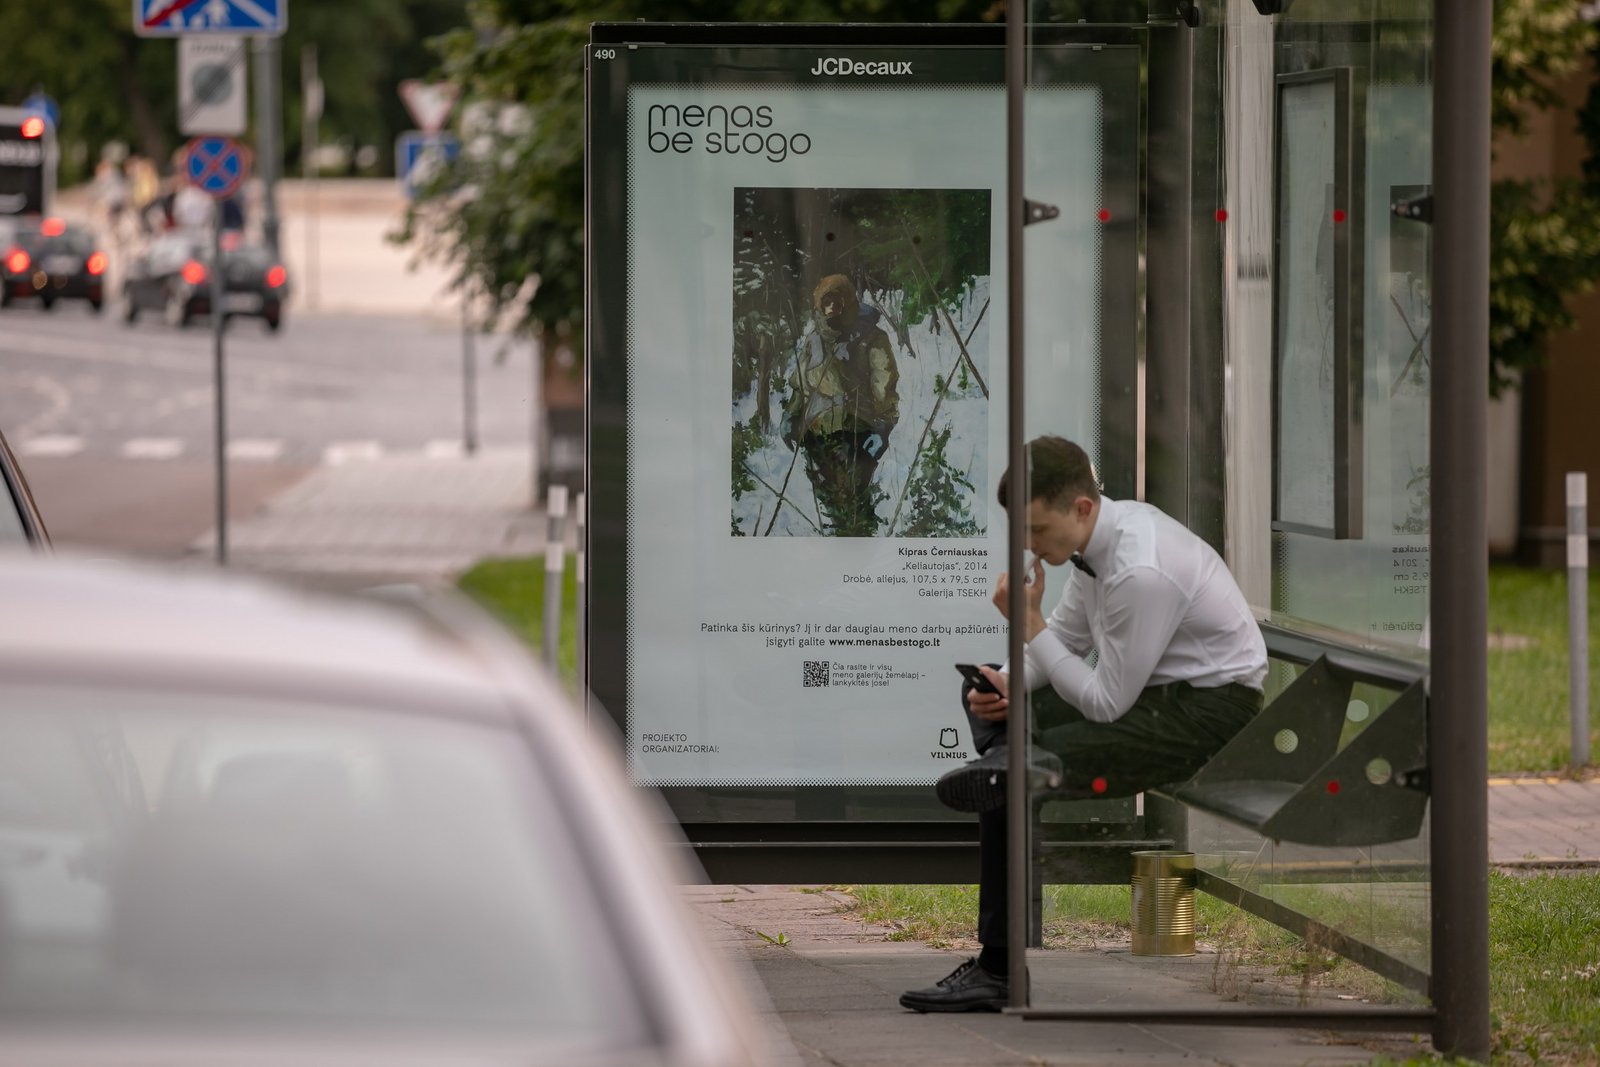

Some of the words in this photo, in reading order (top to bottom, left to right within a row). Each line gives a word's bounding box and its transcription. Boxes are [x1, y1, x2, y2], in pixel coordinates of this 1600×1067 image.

[594, 49, 616, 60] 490
[810, 57, 913, 77] JCDecaux
[647, 103, 773, 128] menas
[648, 128, 694, 154] be
[705, 127, 812, 163] stogo
[898, 547, 928, 558] Kipras
[930, 545, 989, 557] Černiauskas
[964, 561, 988, 571] 2014
[842, 574, 874, 585] Drobė,
[876, 574, 909, 586] aliejus,
[912, 574, 938, 585] 107,5
[940, 576, 947, 584] x
[949, 574, 970, 585] 79,5
[972, 576, 988, 584] cm
[918, 588, 954, 600] Galerija
[956, 588, 987, 598] TSEKH
[700, 622, 739, 633] Patinka
[741, 622, 756, 633] šis
[758, 623, 802, 635] kūrinys?
[803, 623, 811, 635] Jį
[813, 623, 822, 633] ir
[824, 624, 842, 634] dar
[845, 624, 885, 636] daugiau
[888, 626, 918, 634] meno
[921, 624, 952, 636] darbų
[954, 624, 999, 636] apžiūrėti
[765, 636, 796, 649] įsigyti
[798, 636, 826, 649] galite
[828, 637, 941, 650] www.menasbestogo.lt
[832, 661, 845, 671] Čia
[846, 663, 868, 671] rasite
[869, 663, 875, 671] ir
[877, 663, 893, 673] visų
[832, 671, 854, 679] meno
[856, 671, 884, 680] galerijų
[885, 671, 920, 681] žemėlapį
[832, 679, 870, 688] lankykitės
[642, 733, 688, 743] PROJEKTO
[641, 744, 721, 754] ORGANIZATORIAI:
[930, 751, 969, 760] VILNIUS
